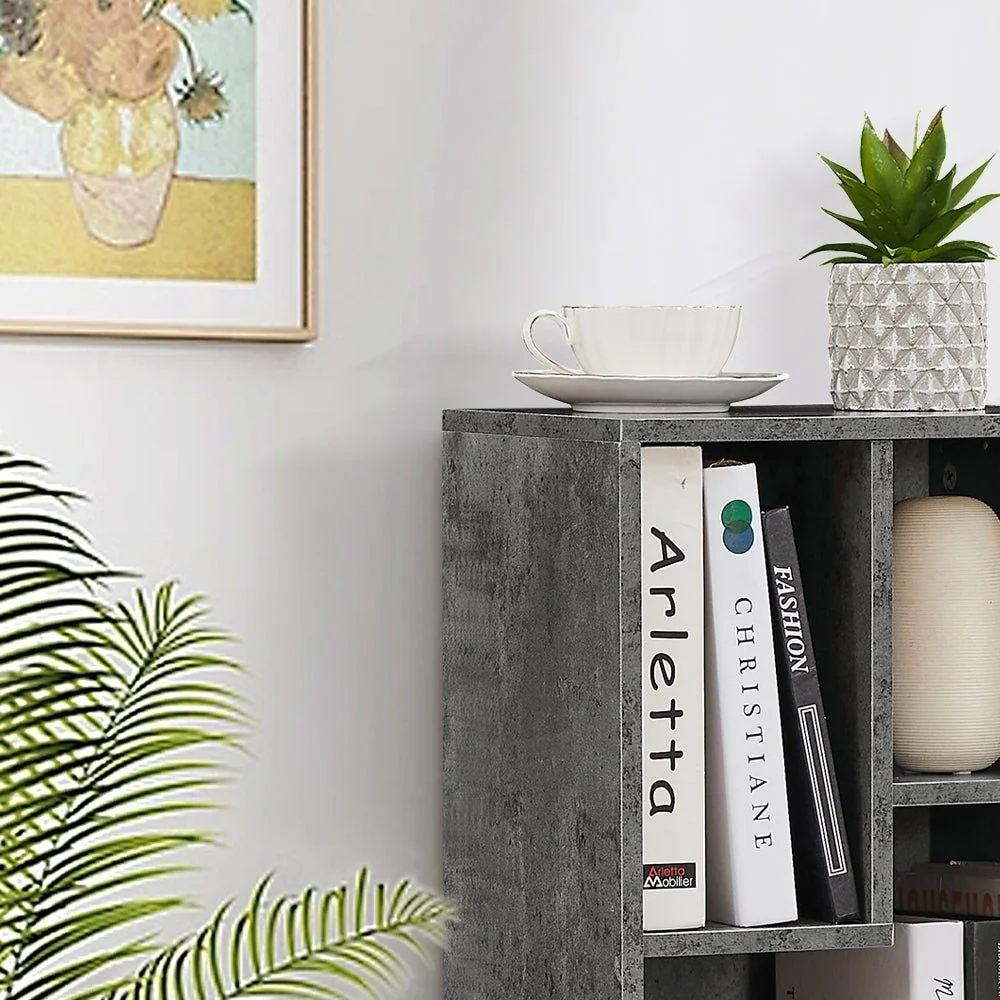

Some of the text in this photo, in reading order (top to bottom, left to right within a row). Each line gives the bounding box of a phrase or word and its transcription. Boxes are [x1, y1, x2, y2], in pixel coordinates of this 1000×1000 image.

[649, 526, 689, 817] Arletta
[773, 565, 810, 673] FASHION
[734, 597, 774, 848] CHRISTIANE
[648, 865, 686, 877] Arletta
